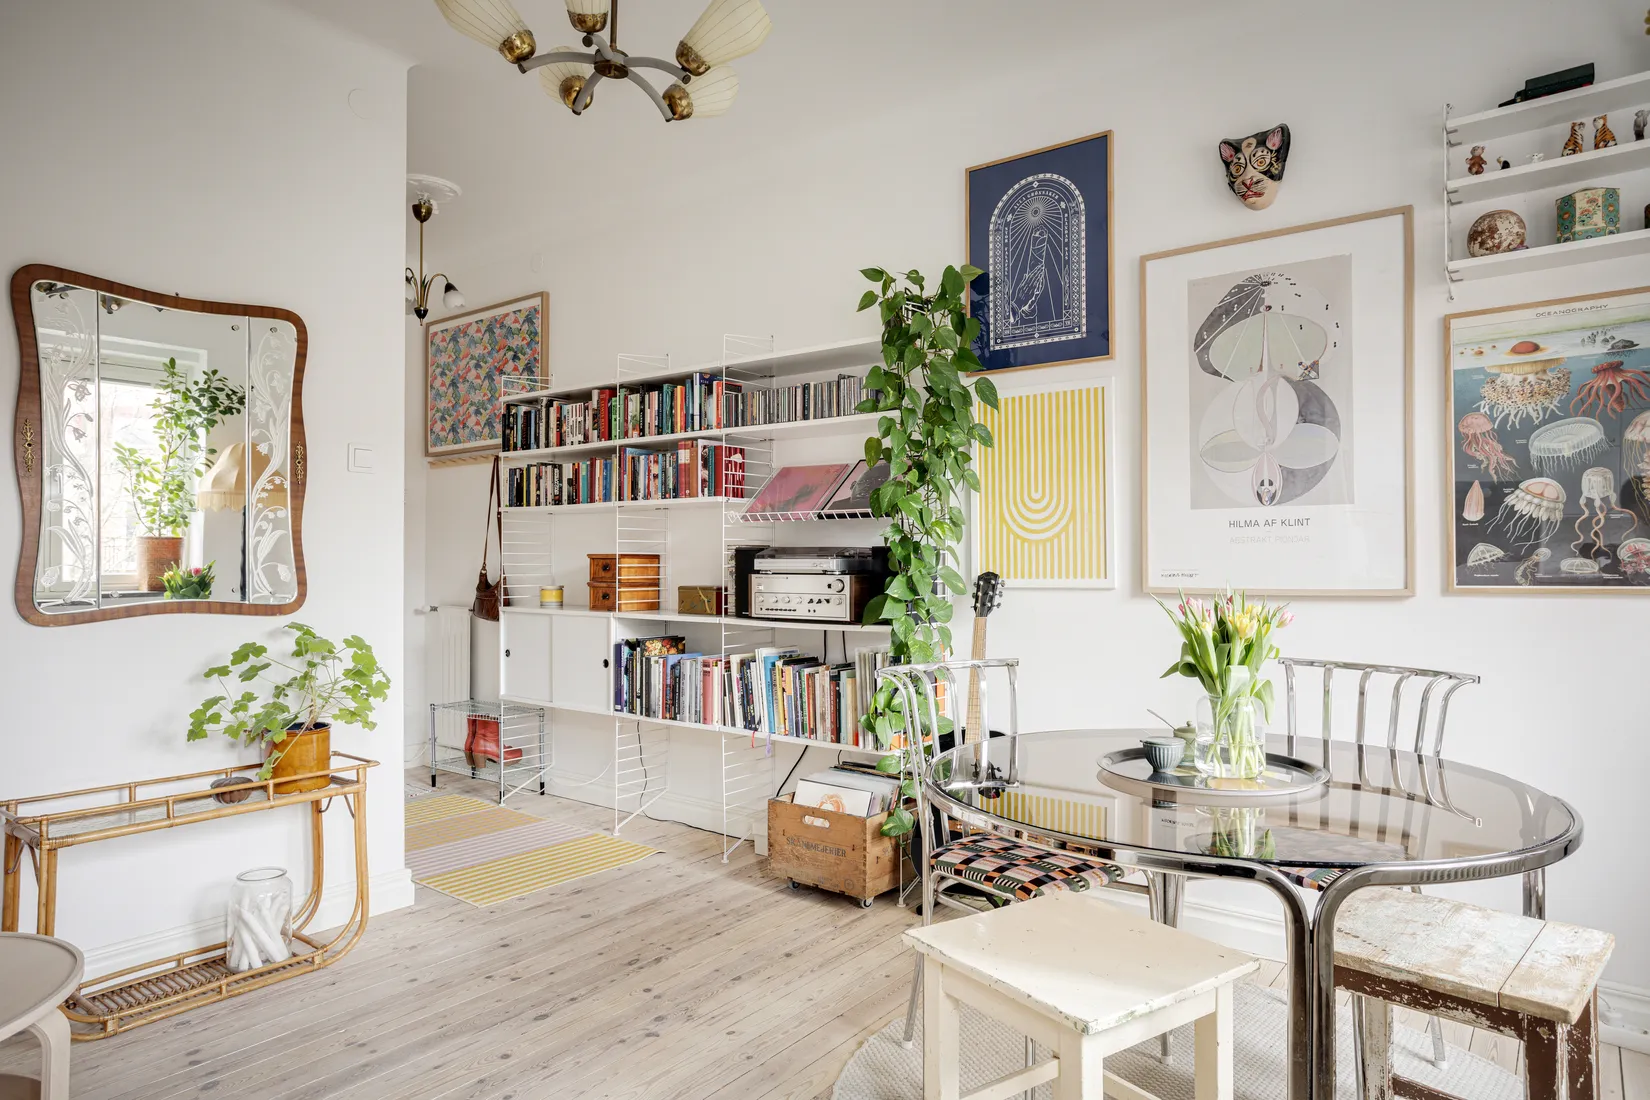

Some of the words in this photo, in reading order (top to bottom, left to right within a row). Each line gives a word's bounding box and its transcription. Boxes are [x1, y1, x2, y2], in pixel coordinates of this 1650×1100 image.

[1535, 304, 1609, 318] OCEANOGRAPHY
[1228, 519, 1260, 528] HILMA
[1263, 518, 1278, 527] AF
[1280, 517, 1311, 527] KLINT
[1229, 535, 1273, 544] ABSTRAKT
